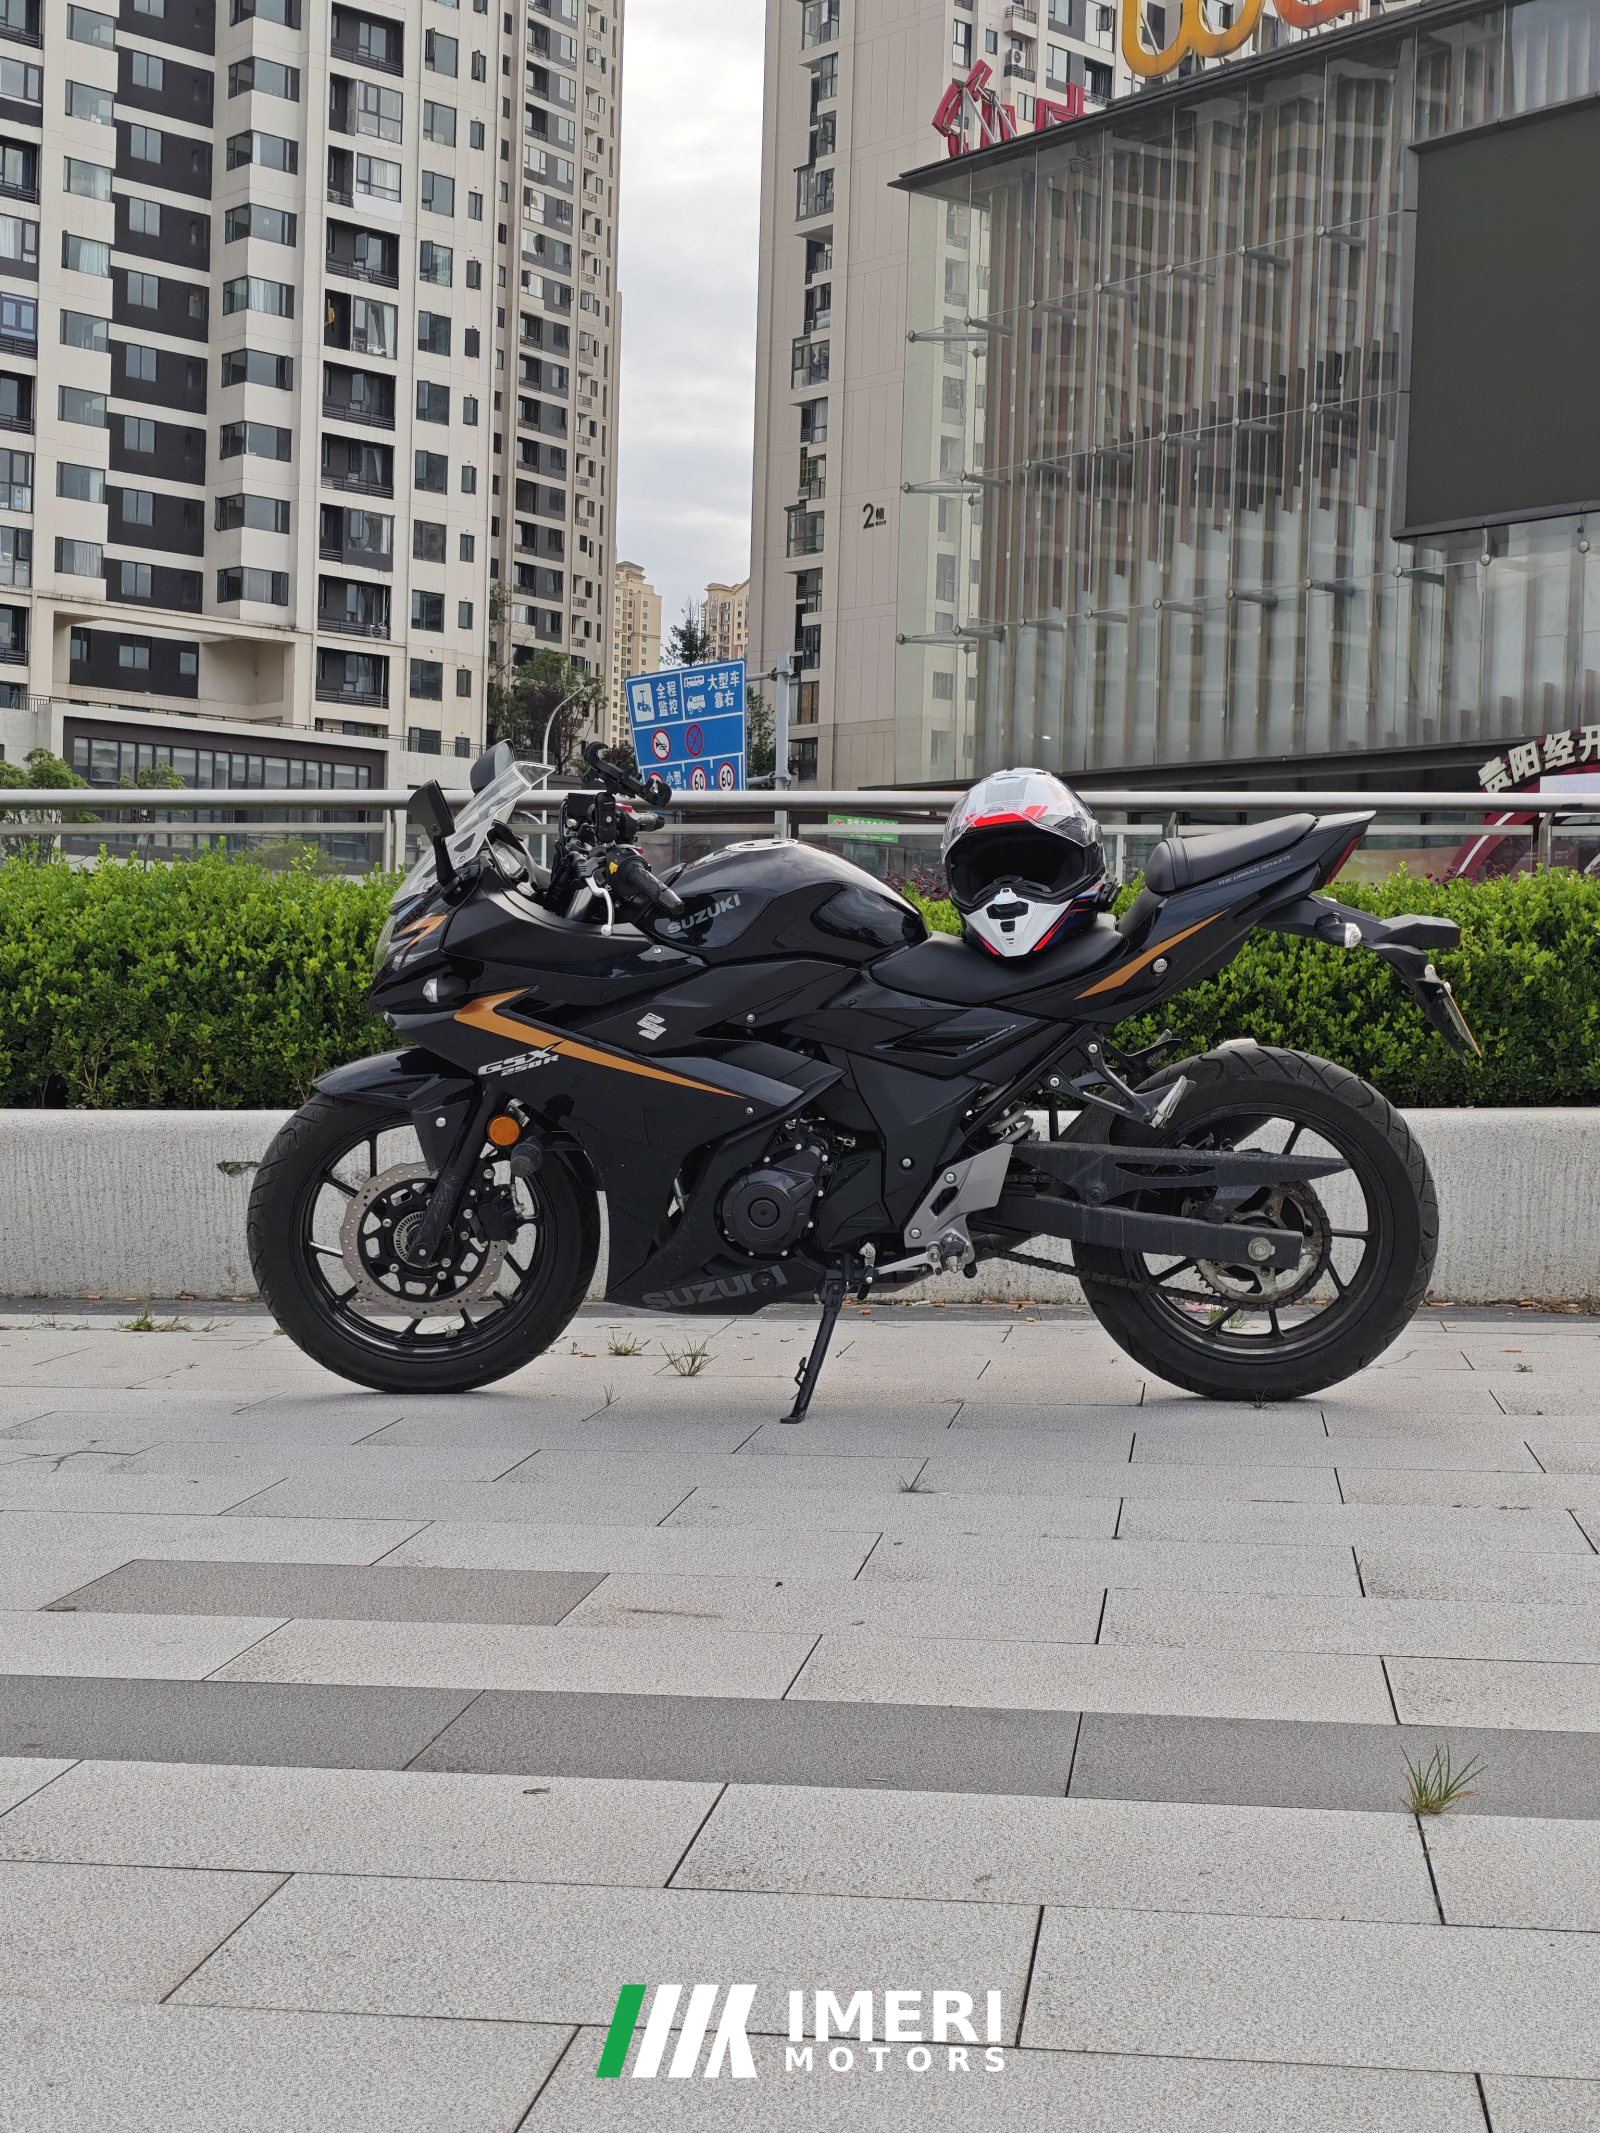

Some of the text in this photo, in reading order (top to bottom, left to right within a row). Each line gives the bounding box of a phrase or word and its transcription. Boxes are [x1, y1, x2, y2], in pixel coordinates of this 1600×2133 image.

[656, 680, 677, 699] 全程
[707, 671, 740, 691] 大型车
[658, 699, 679, 717] 监控
[714, 690, 735, 709] 靠右
[694, 774, 703, 790] 60
[722, 769, 732, 786] 60
[667, 894, 741, 934] SUZUKI
[478, 1044, 556, 1076] GSX
[501, 1054, 559, 1077] 250R
